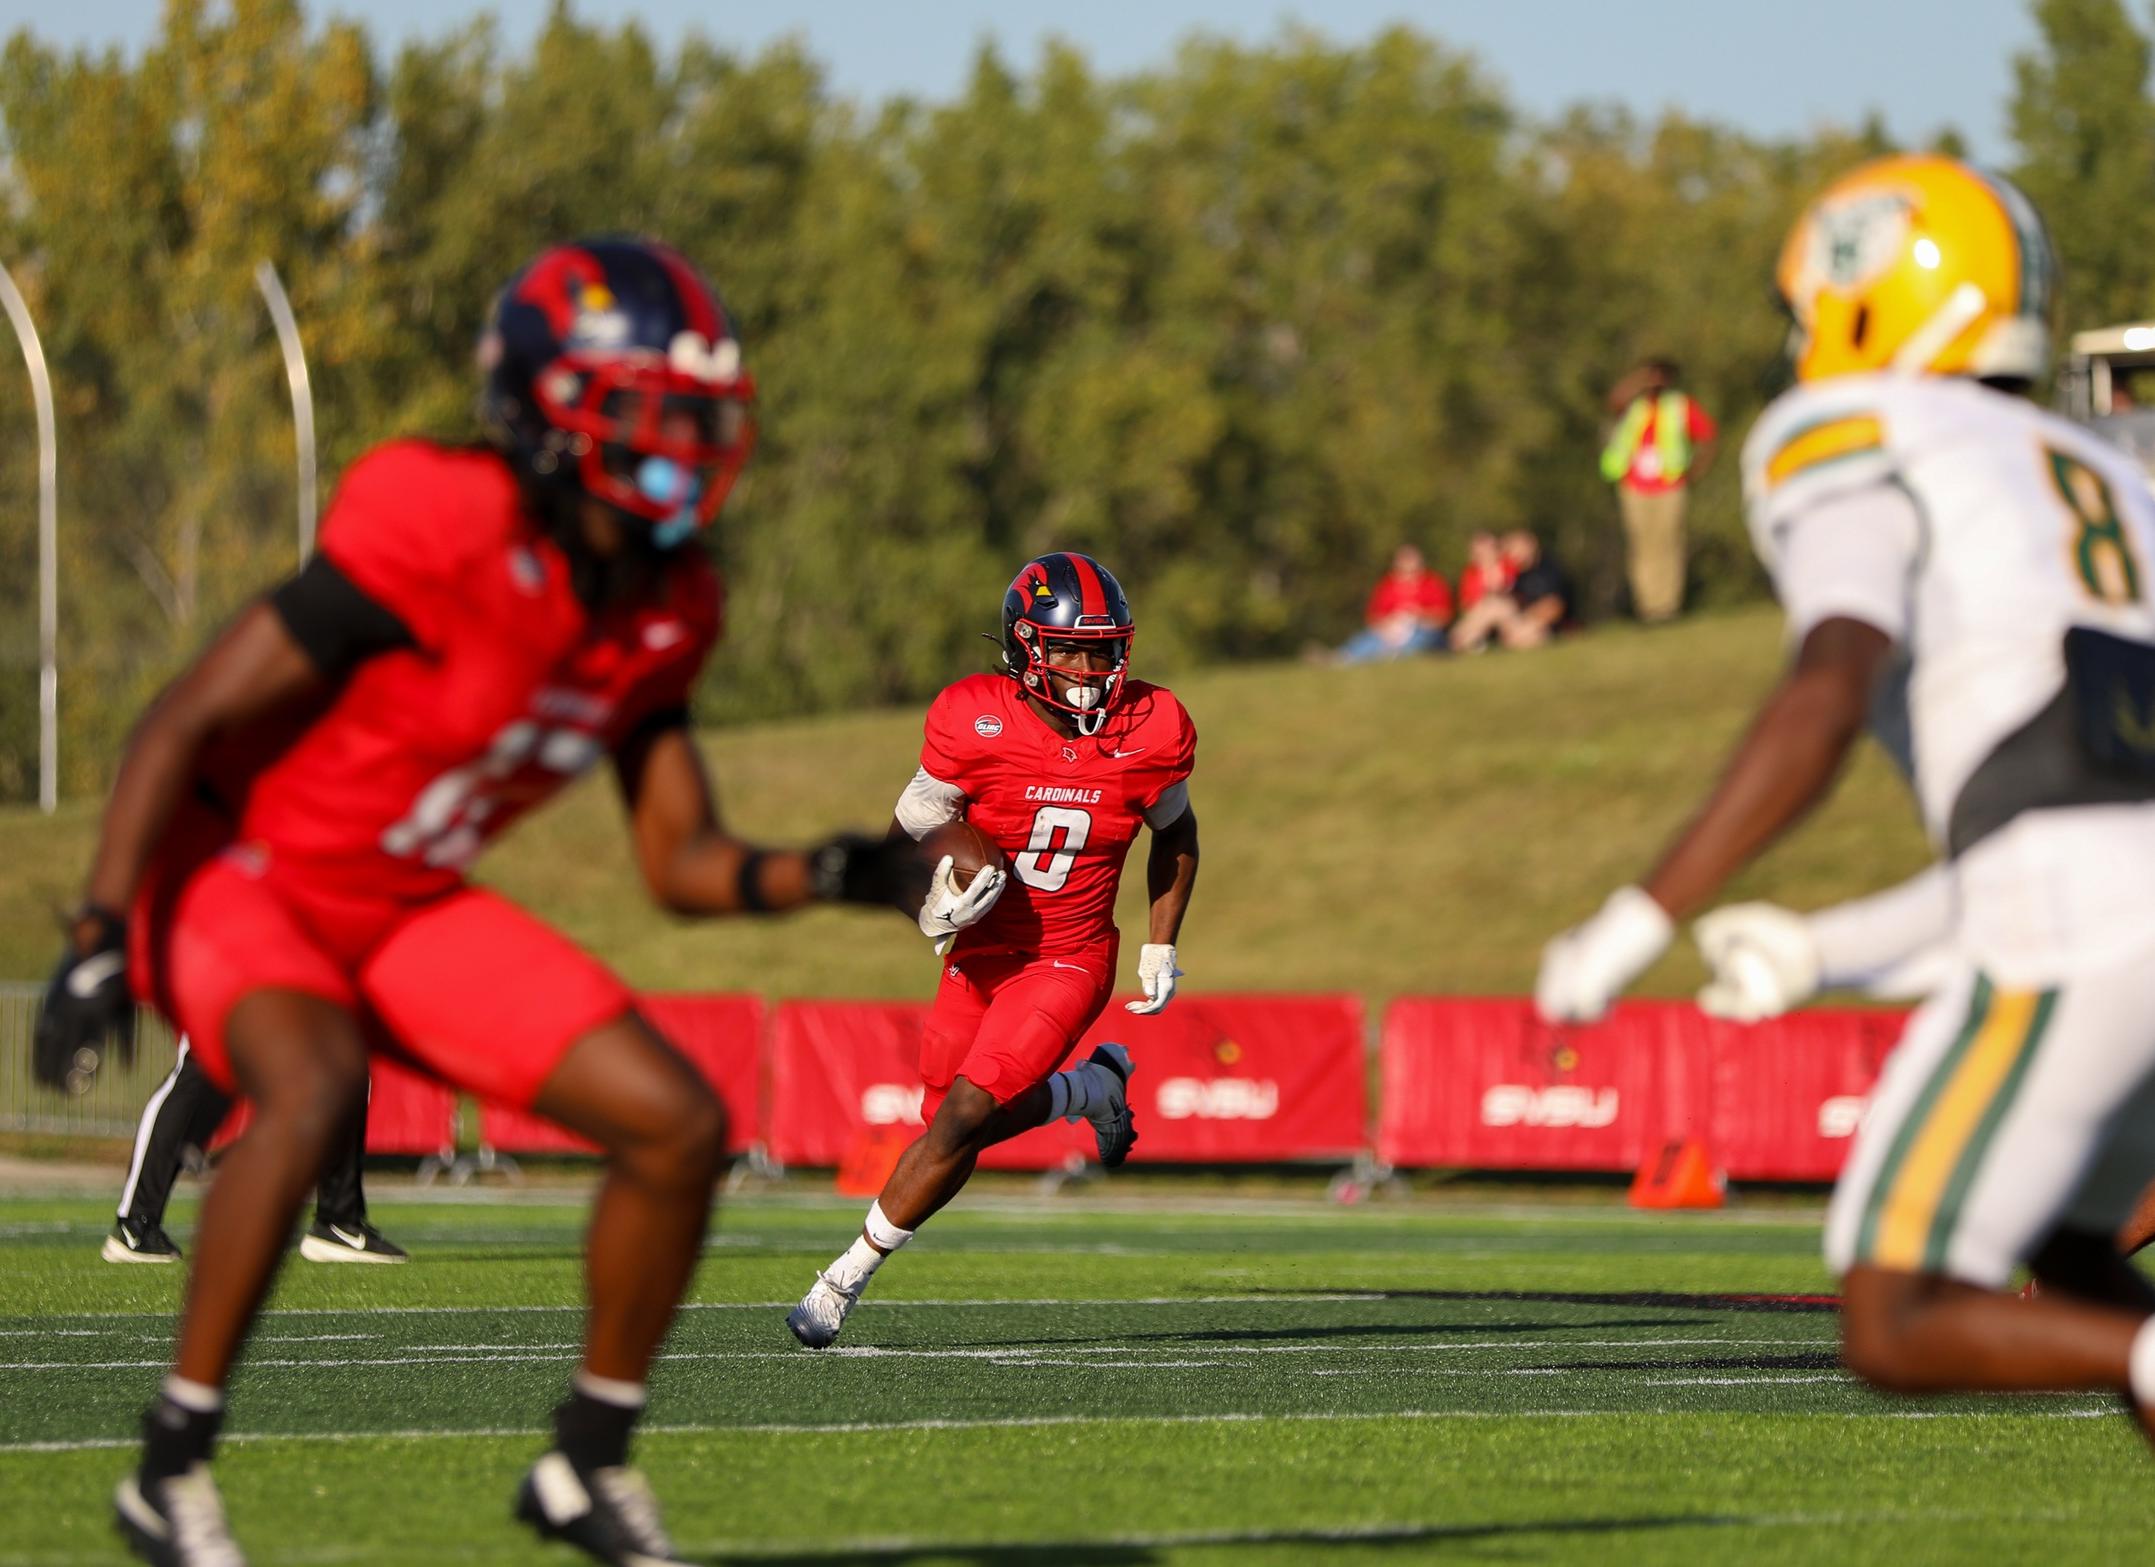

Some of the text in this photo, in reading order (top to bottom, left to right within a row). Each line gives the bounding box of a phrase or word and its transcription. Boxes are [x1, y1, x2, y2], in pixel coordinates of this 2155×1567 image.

[2042, 445, 2142, 604] 8
[1025, 785, 1102, 803] CARDINALS
[1013, 805, 1092, 892] 0
